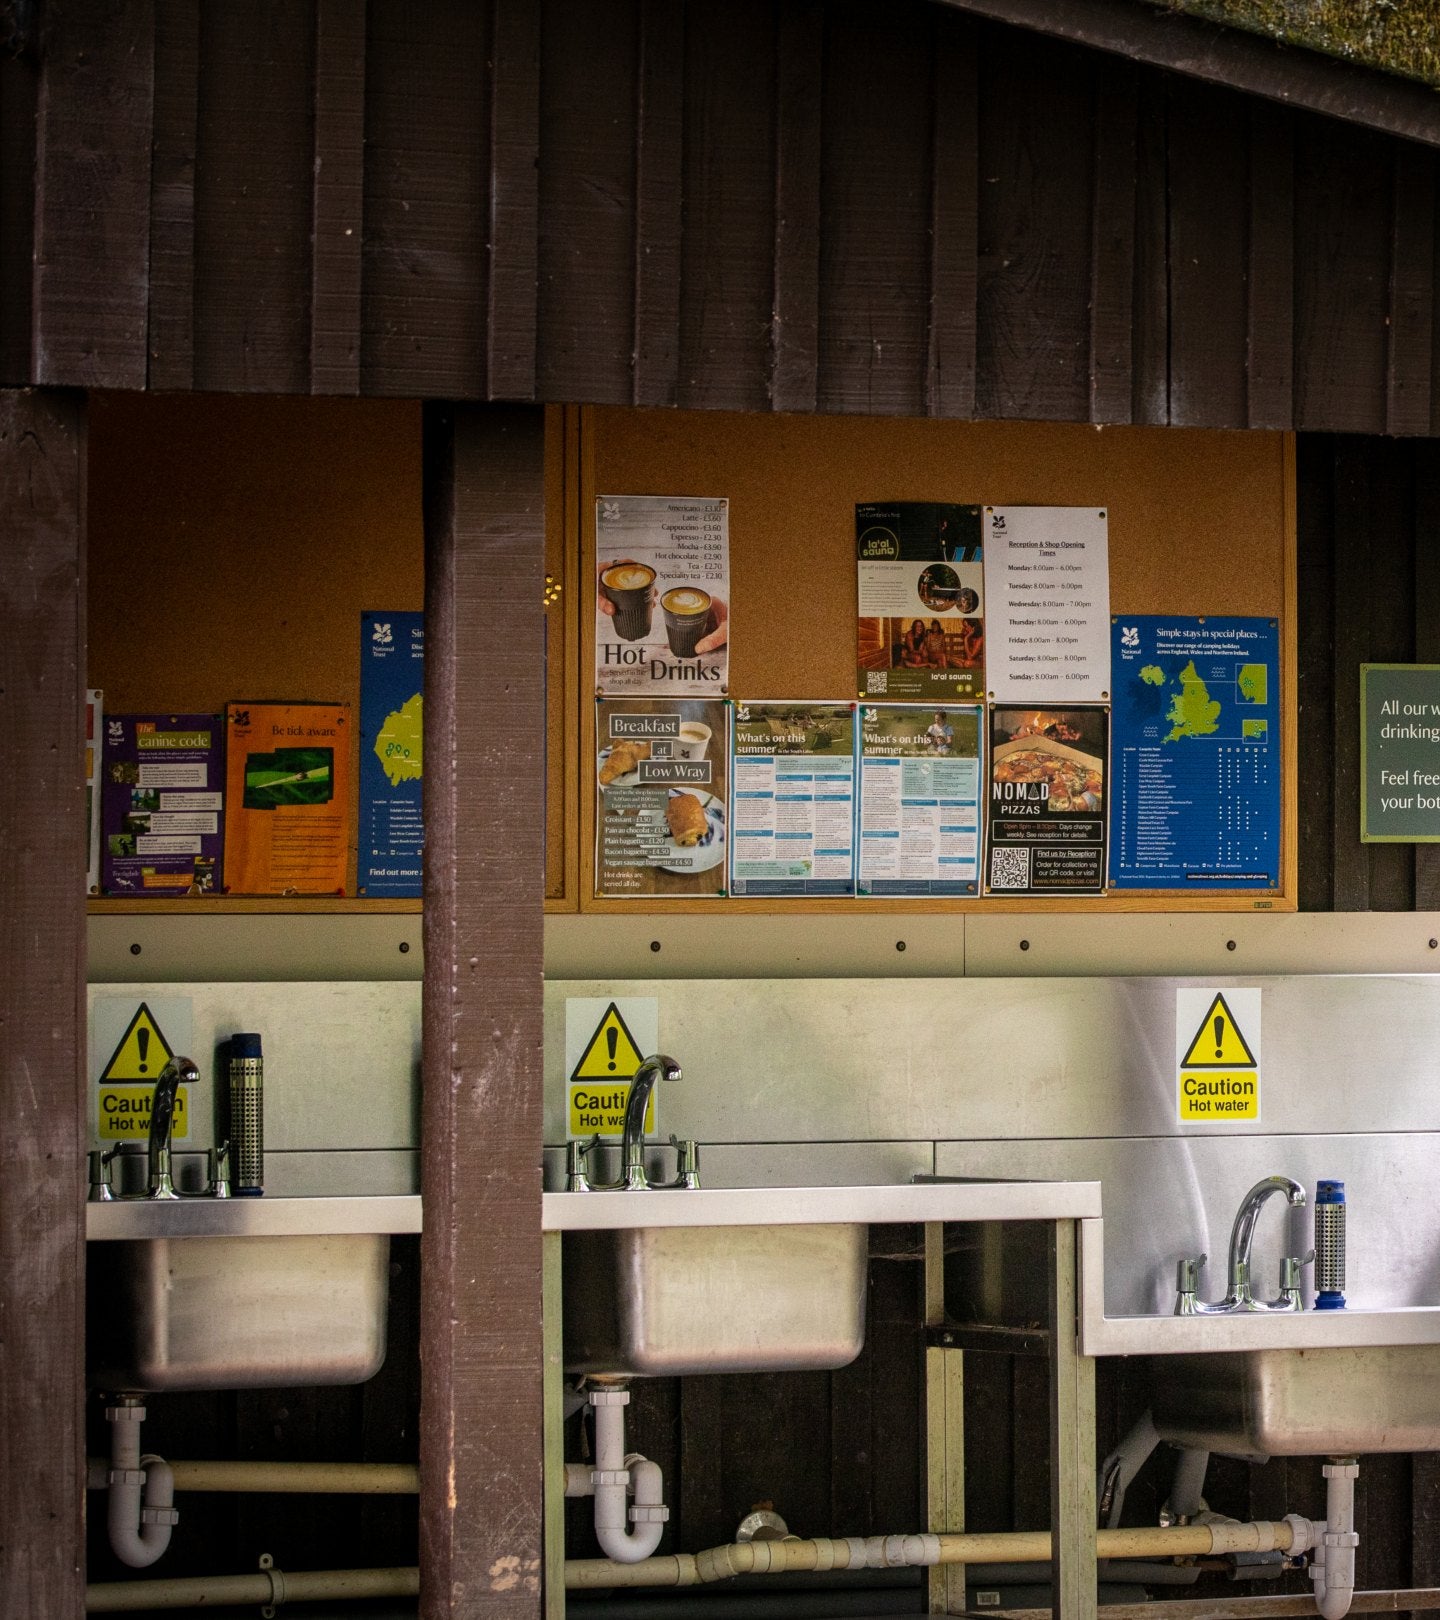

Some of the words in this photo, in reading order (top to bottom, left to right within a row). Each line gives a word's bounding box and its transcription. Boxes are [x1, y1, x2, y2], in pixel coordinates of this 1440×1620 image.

[666, 504, 700, 512] Americano
[682, 514, 699, 522] Latte
[661, 524, 699, 533] Cappuccino
[703, 524, 721, 532] £3.60
[670, 534, 699, 542] Espresso
[677, 543, 699, 551] Mocha
[868, 539, 889, 549] la'al
[1008, 540, 1038, 549] Reception
[1039, 541, 1044, 549] &
[1044, 541, 1060, 550] Shop
[1060, 541, 1086, 550] Opening
[863, 547, 894, 556] sauna
[1039, 549, 1056, 557] Times
[655, 552, 666, 560] Hot
[667, 552, 699, 560] chocolate
[704, 553, 722, 561] £2.90
[1008, 564, 1033, 573] Monday:
[659, 572, 689, 581] Speciality
[705, 572, 723, 580] £2.10
[1008, 582, 1033, 591] Tuesday:
[1008, 600, 1042, 609] Wednesday:
[1070, 600, 1092, 609] 7.00pm
[1008, 619, 1037, 627] Thursday:
[1156, 628, 1181, 639] Simple
[1182, 629, 1201, 640] stays
[1201, 628, 1209, 637] in
[1210, 629, 1235, 641] special
[1235, 630, 1258, 641] places
[1008, 637, 1028, 645] Friday:
[372, 645, 395, 653] National
[604, 643, 646, 665] Hot
[1008, 655, 1037, 663] Saturday:
[650, 659, 721, 681] Drinks
[931, 673, 947, 681] la'al
[948, 673, 972, 681] sauna
[1009, 673, 1035, 682] Sunday:
[1065, 673, 1090, 682] 6.00pm
[1380, 699, 1399, 715] All
[1403, 704, 1428, 716] our
[140, 723, 154, 733] The
[272, 725, 285, 736] Be
[287, 724, 305, 736] tick
[308, 727, 336, 736] aware
[614, 718, 676, 733] Breakfast
[1380, 723, 1440, 742] drinking
[138, 734, 176, 747] canine
[179, 733, 209, 747] code
[736, 732, 771, 743] What's
[772, 735, 786, 743] on
[787, 733, 806, 743] this
[864, 733, 898, 743] What's
[899, 736, 911, 744] on
[913, 734, 932, 744] this
[657, 746, 667, 755] at
[736, 745, 777, 754] summer
[864, 746, 904, 755] summer
[645, 764, 672, 777] Low
[674, 764, 706, 781] Wray
[1381, 770, 1409, 785] Feel
[1413, 770, 1440, 785] free
[1380, 797, 1414, 812] your
[1000, 805, 1041, 815] PIZZAS
[1059, 824, 1073, 832] Days
[1073, 824, 1093, 832] change
[1037, 832, 1062, 840] reception
[619, 838, 645, 847] baguette
[623, 848, 649, 857] baguette
[1059, 850, 1067, 859] by
[605, 859, 623, 867] Vegan
[646, 859, 671, 867] baguette
[369, 868, 386, 876] Find
[386, 869, 400, 877] out
[400, 869, 419, 877] more
[1049, 869, 1059, 877] QR
[1183, 1078, 1254, 1096] Caution
[103, 1094, 184, 1114] Cautn
[1189, 1099, 1211, 1111] Hot
[1214, 1099, 1250, 1111] water
[109, 1117, 134, 1130] Hot
[579, 1113, 604, 1127] Hot
